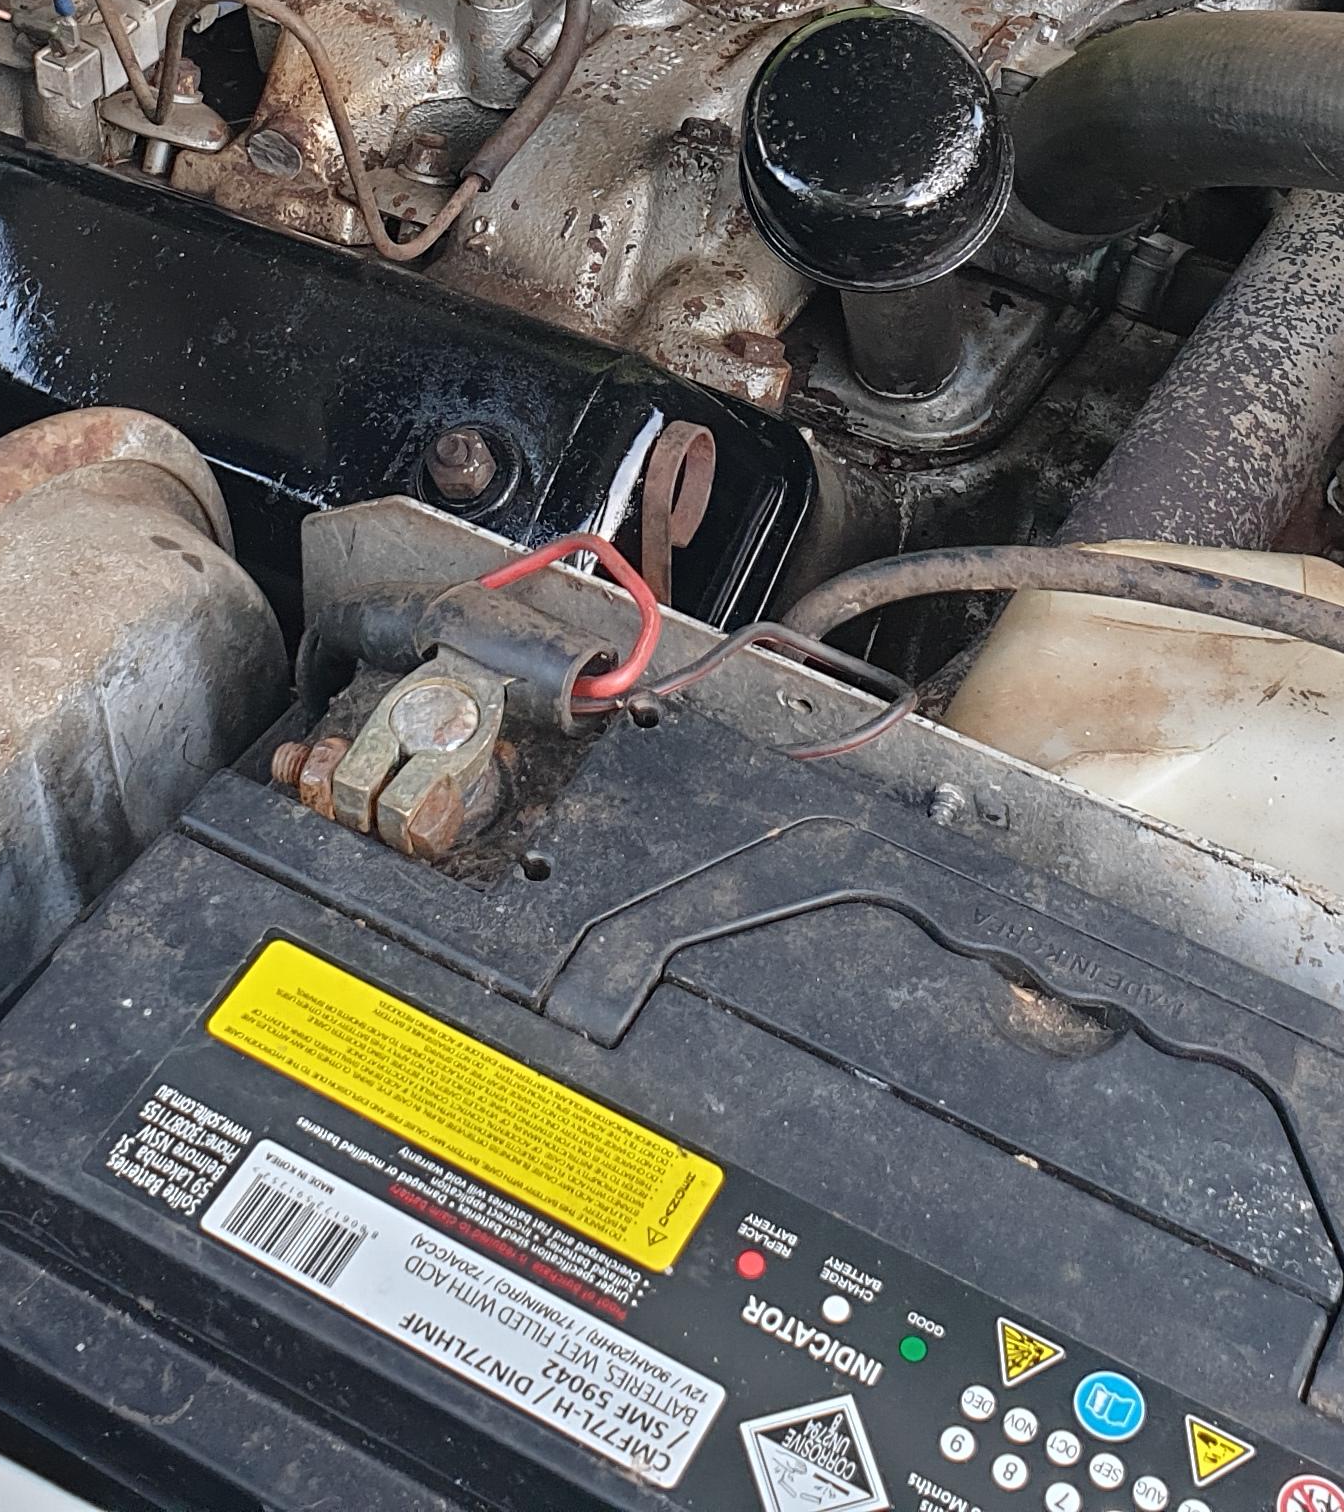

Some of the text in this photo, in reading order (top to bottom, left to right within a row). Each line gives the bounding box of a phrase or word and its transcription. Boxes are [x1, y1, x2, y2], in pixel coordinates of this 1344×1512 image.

[154, 1084, 252, 1145] www.solite.com.au
[113, 1134, 214, 1199] 59 Lakemba St
[135, 1124, 227, 1182] Belmore NSW
[265, 1152, 335, 1195] MADE IN KOREA
[296, 1117, 448, 1205] Damaged or modified batteries
[162, 1183, 202, 1216] Solite
[398, 1146, 641, 1283] Overcharged and Flat batteries will void warranty
[430, 1176, 532, 1238] Incorrect application
[738, 1223, 792, 1258] REPLACE
[744, 1213, 798, 1246] BATTERY
[410, 1234, 484, 1281] 720A(CCA)
[457, 1203, 629, 1303] Under specification sized batteries
[545, 1238, 636, 1293] Sulfated batteries
[820, 1267, 874, 1302] CHARGE
[824, 1256, 882, 1292] BATTERY
[493, 1279, 575, 1330] 170MIN(RC)
[907, 1312, 945, 1337] GOOD
[404, 1255, 699, 1427] BATTERIES, WET, FILLED WITH ACID
[586, 1329, 671, 1383] 90AH(20HR)
[742, 1295, 882, 1386] INDICATOR
[398, 1313, 671, 1472] CMF77L-H / DIN77LHMF
[541, 1359, 690, 1450] / SMF 59042
[679, 1384, 708, 1403] 12V
[963, 1387, 993, 1414] DEC
[803, 1416, 851, 1456] UN2794
[950, 1434, 965, 1453] 9
[1002, 1409, 1035, 1438] NOV
[781, 1428, 856, 1481] CORROSIVE
[1048, 1436, 1078, 1459] OCT
[908, 1472, 968, 1512] Months
[1003, 1462, 1018, 1481] 8
[1092, 1462, 1122, 1482] SEP
[1131, 1478, 1165, 1505] AUG
[1054, 1492, 1069, 1511] 7
